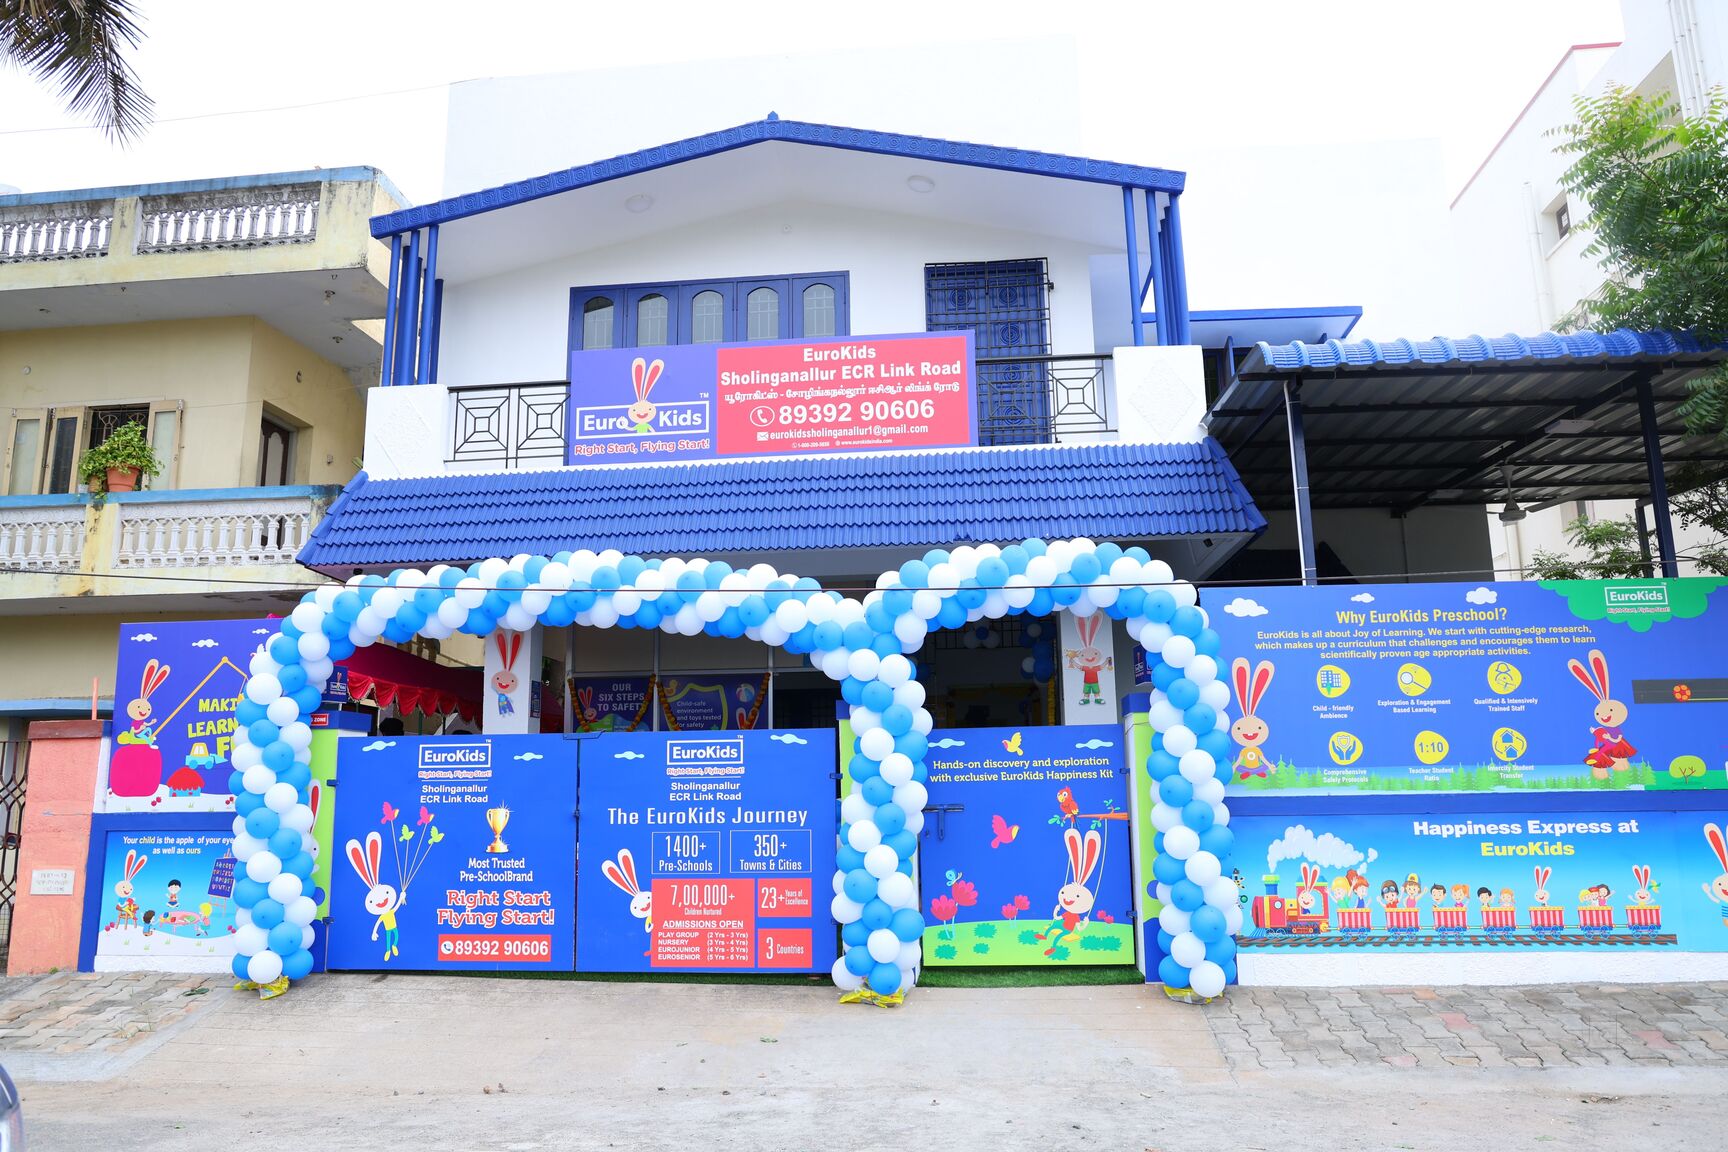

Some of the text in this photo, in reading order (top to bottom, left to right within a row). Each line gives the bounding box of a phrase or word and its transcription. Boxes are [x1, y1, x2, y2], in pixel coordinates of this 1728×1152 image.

[803, 345, 876, 362] EuroKids
[720, 361, 961, 387] Sholinganallur ECR Link Road
[779, 399, 934, 425] 89392 90606
[584, 409, 702, 431] Euro Kids
[770, 424, 929, 440] eurokidssholinganallur1@gmail.com
[575, 439, 710, 456] Right Start, Flying Start!
[1610, 591, 1664, 601] EuroKids
[1336, 607, 1508, 627] Why EuroKids Preschool?
[1257, 625, 1592, 640] EuroKids is all about Joy of Learning. We start with cutting-edge research,
[1254, 641, 1282, 650] which
[1284, 640, 1314, 649] makes
[1315, 641, 1328, 650] up
[1337, 639, 1387, 648] curriculum
[1388, 639, 1407, 648] that
[1408, 638, 1458, 648] challenges
[1460, 637, 1477, 646] and
[1479, 637, 1534, 646] encourages
[1535, 636, 1559, 645] them
[1560, 636, 1571, 644] to
[1572, 635, 1596, 643] learn
[1320, 647, 1532, 660] scientifically proven age appropriate activities.
[612, 683, 631, 692] OUR
[599, 693, 645, 701] SIX STEPS
[1377, 699, 1409, 707] Exploration
[1416, 698, 1451, 707] Engagement
[1507, 697, 1538, 705] Intensively
[199, 698, 237, 712] MAKI
[597, 703, 643, 711] TO SAFET
[1411, 706, 1437, 714] Learning
[1511, 704, 1525, 712] Staff
[188, 717, 239, 738] LEARN
[673, 746, 738, 759] EuroKids
[1418, 742, 1444, 754] 1:10
[424, 749, 486, 762] EuroKids
[933, 757, 1110, 769] Hands-on discovery and exploration
[929, 769, 1114, 783] with exclusive EuroKids Happiness Kit
[422, 785, 487, 794] Sholinganallur
[671, 782, 740, 792] Sholinganallur
[420, 795, 488, 803] ECR Link Road
[670, 792, 742, 801] ECR Link Road
[608, 807, 808, 827] The EuroKids Journey
[1413, 820, 1639, 838] Happiness Express at
[123, 836, 138, 845] Your
[139, 836, 155, 844] child
[157, 836, 163, 844] is
[164, 836, 175, 844] the
[176, 836, 194, 845] apple
[197, 836, 205, 844] of
[205, 837, 221, 845] your
[665, 835, 707, 858] 1400+
[754, 834, 788, 857] 350+
[1481, 841, 1575, 857] EuroKids
[468, 857, 525, 869] Most Trusted
[659, 860, 713, 872] Pre-Schools
[739, 859, 802, 871] Towns & Cities
[460, 870, 533, 882] Pre-SchoolBrand
[447, 889, 551, 908] Right Start
[670, 884, 736, 908] 7,00,000+
[761, 886, 785, 909] 23+
[785, 889, 803, 898] Years of
[437, 909, 555, 928] Flying Start!
[663, 920, 744, 929] ADMISSIONS OPEN
[455, 940, 549, 956] 89392 90606
[766, 937, 805, 960] 3 Countries
